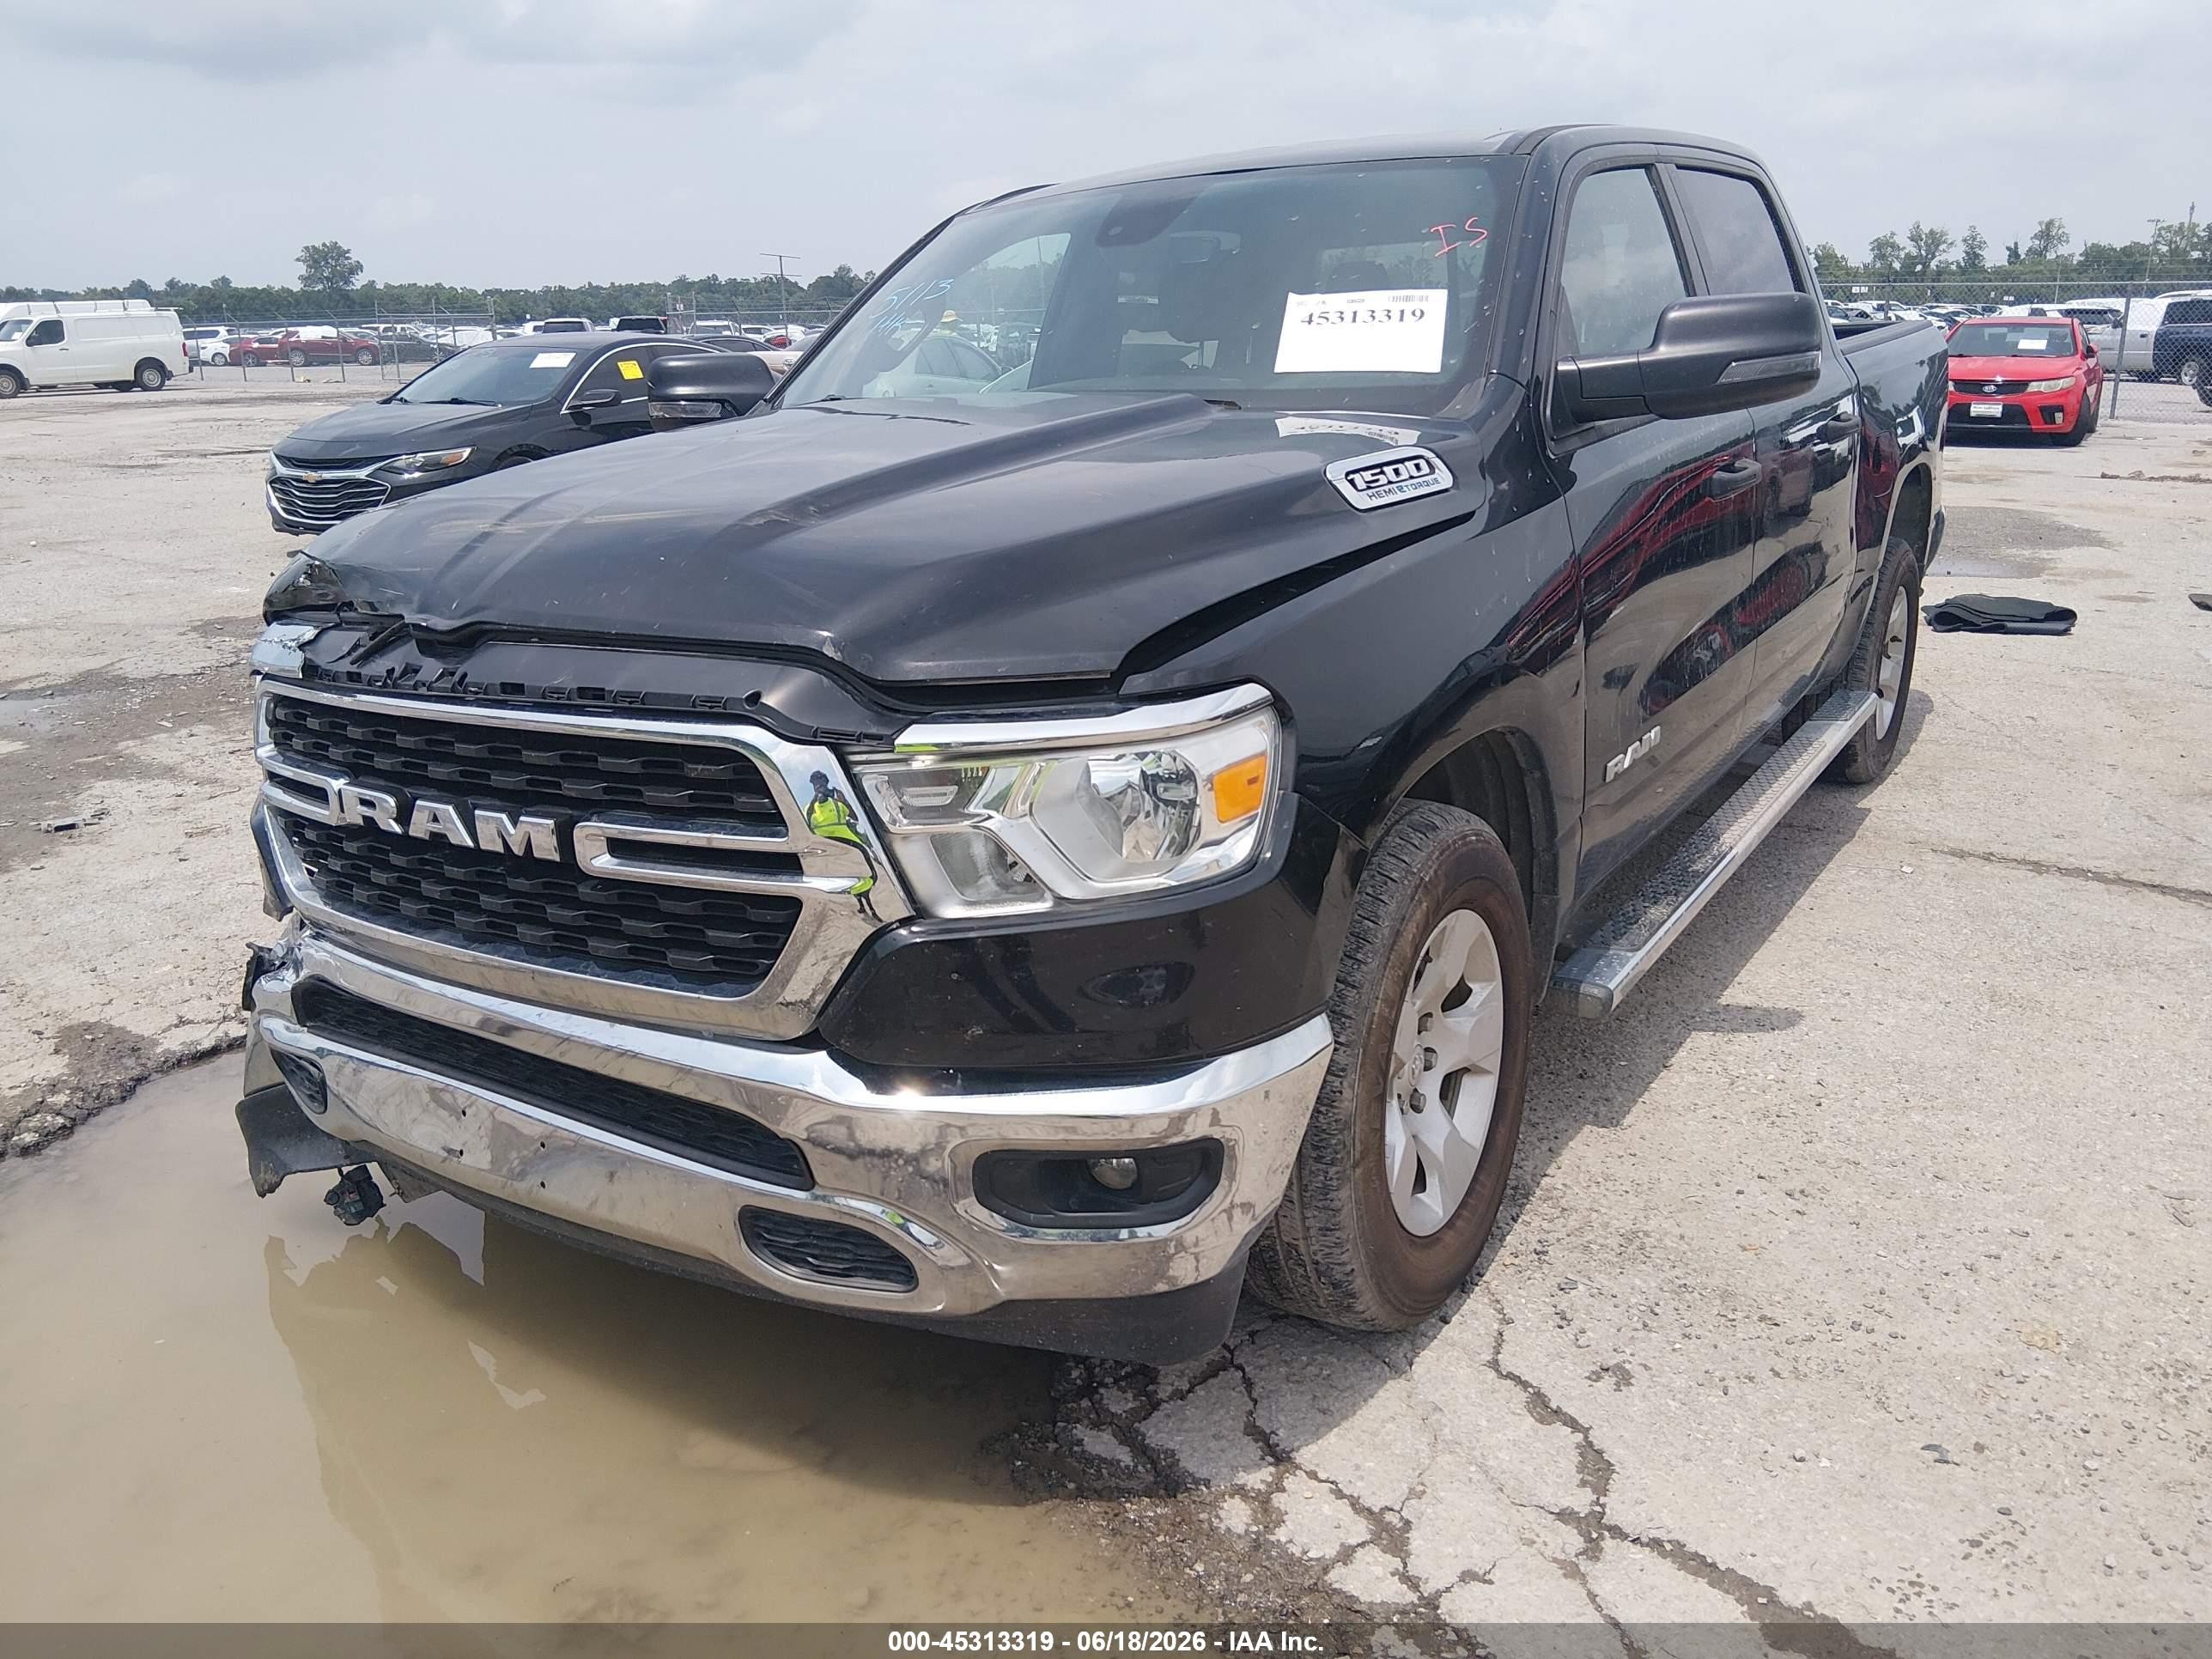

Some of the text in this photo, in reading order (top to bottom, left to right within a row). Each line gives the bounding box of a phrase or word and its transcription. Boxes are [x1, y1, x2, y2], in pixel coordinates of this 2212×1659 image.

[1300, 307, 1425, 325] 45313319
[1346, 459, 1431, 490] 1500
[1606, 726, 1662, 783] RAM
[340, 783, 561, 863] RAM
